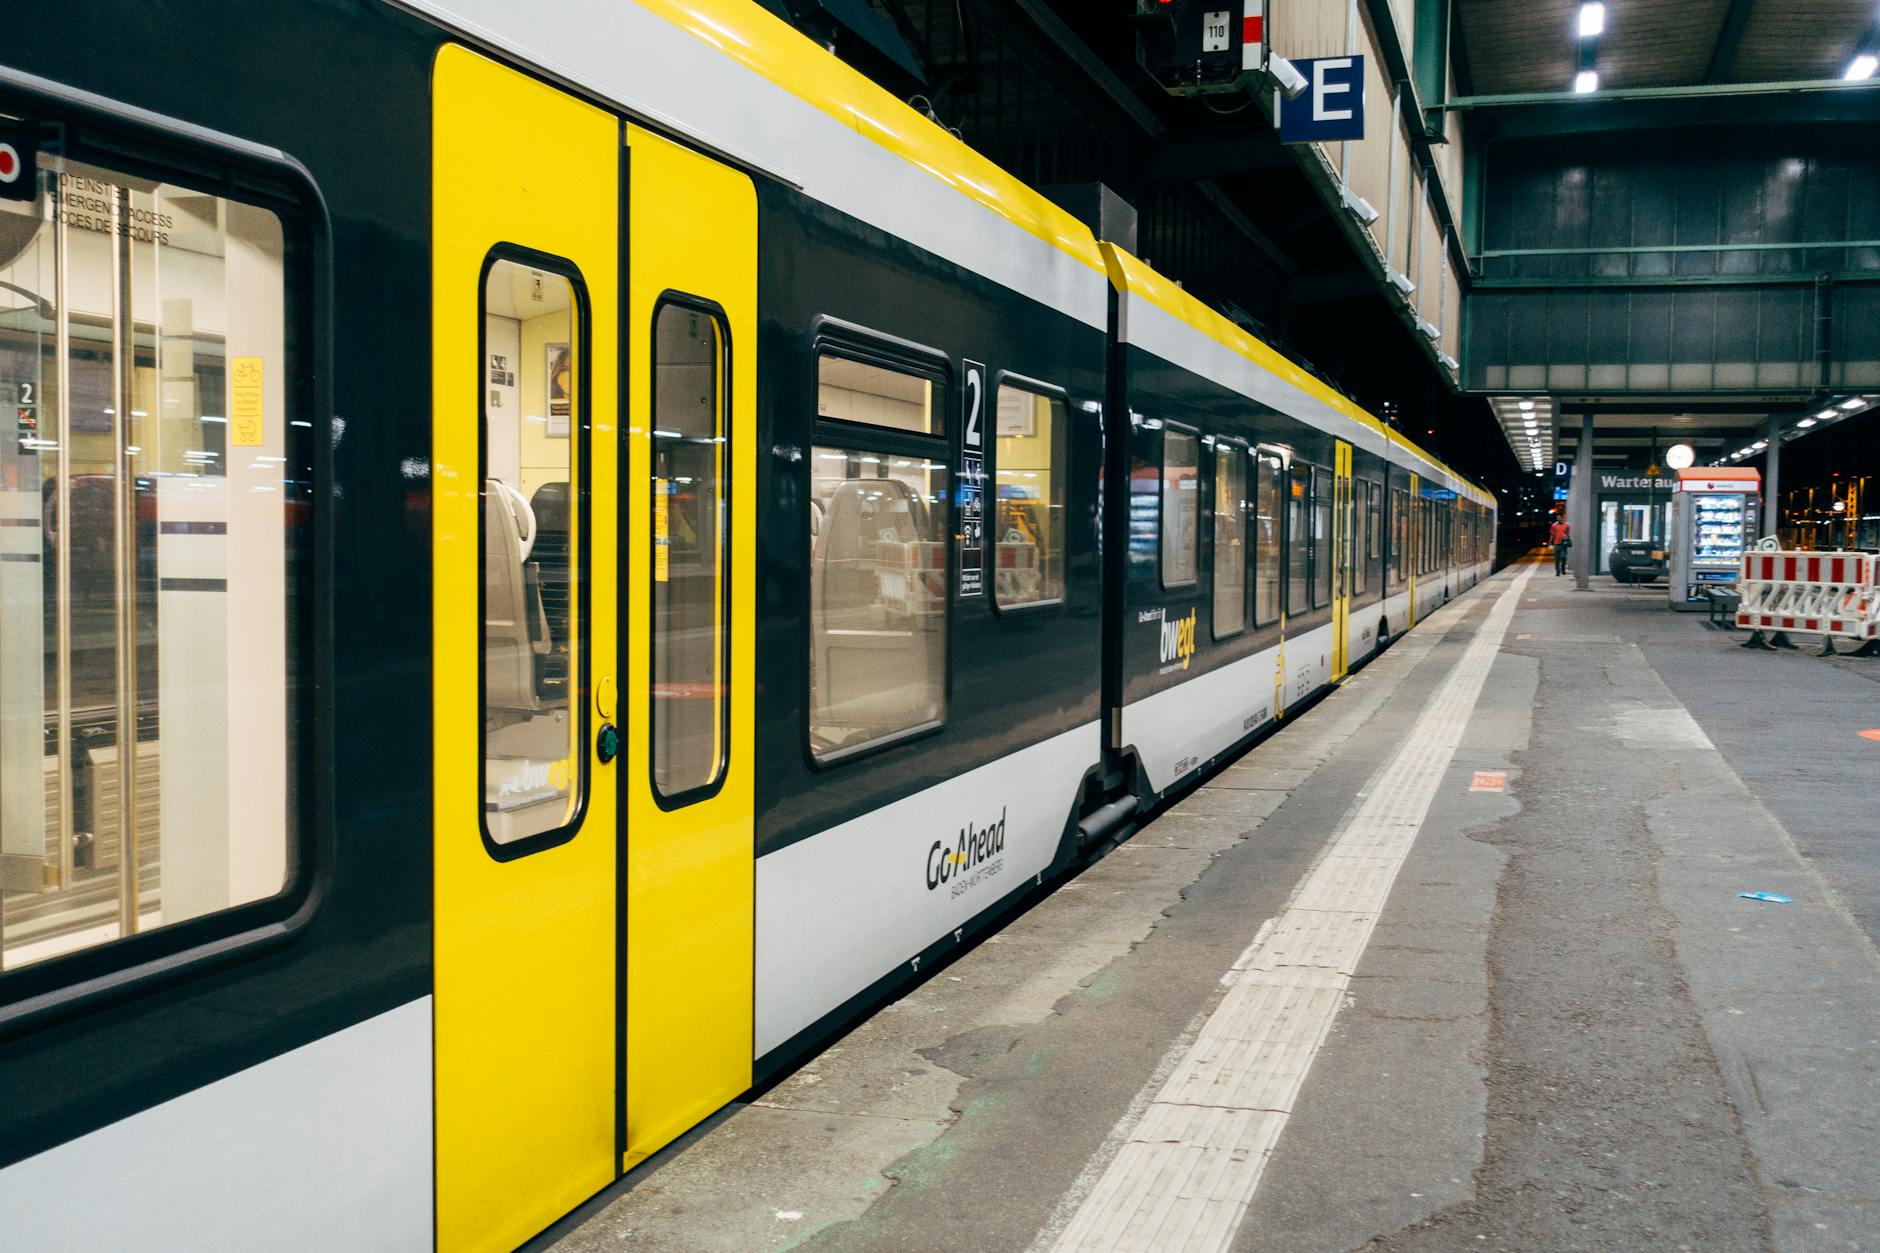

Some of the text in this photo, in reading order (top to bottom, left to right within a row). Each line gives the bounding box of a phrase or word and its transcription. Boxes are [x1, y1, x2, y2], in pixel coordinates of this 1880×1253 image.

[1208, 24, 1225, 39] 110
[1312, 58, 1353, 122] E
[59, 172, 130, 201] OTEINSTIEG
[127, 207, 173, 229] ACCESS
[21, 383, 33, 404] 2
[965, 368, 981, 447] 2
[1555, 462, 1568, 476] D
[1160, 606, 1197, 670] bwegt
